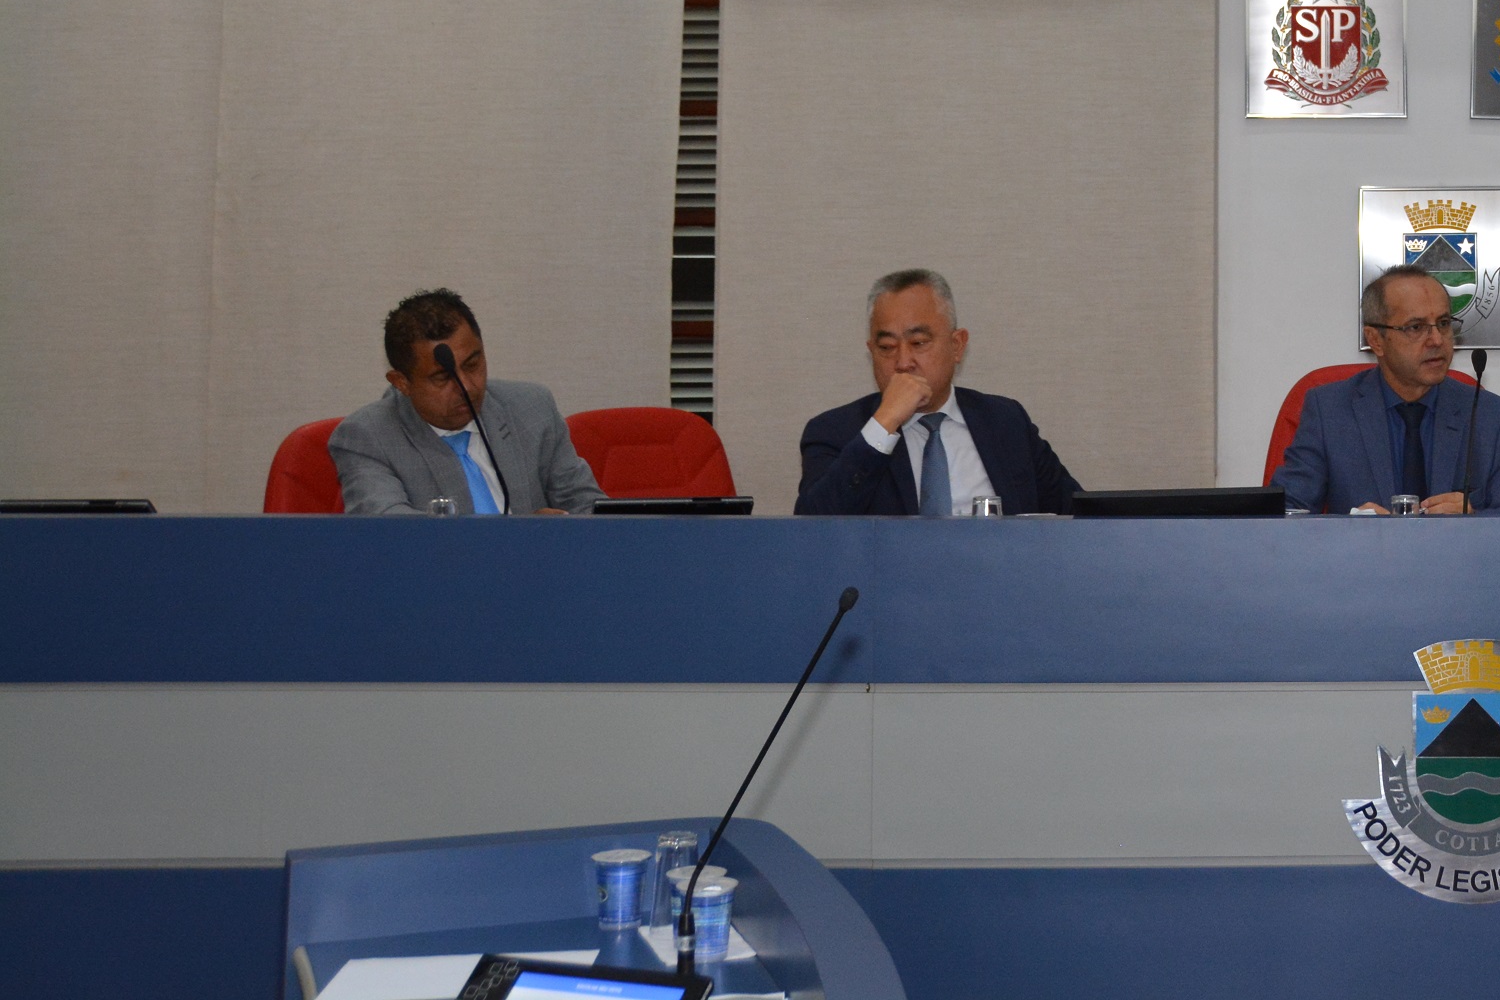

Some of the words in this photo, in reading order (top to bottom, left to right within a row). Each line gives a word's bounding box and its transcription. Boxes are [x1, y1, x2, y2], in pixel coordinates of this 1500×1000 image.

[1481, 285, 1496, 311] 1856
[1388, 775, 1412, 814] 1723
[1353, 801, 1431, 882] PODER
